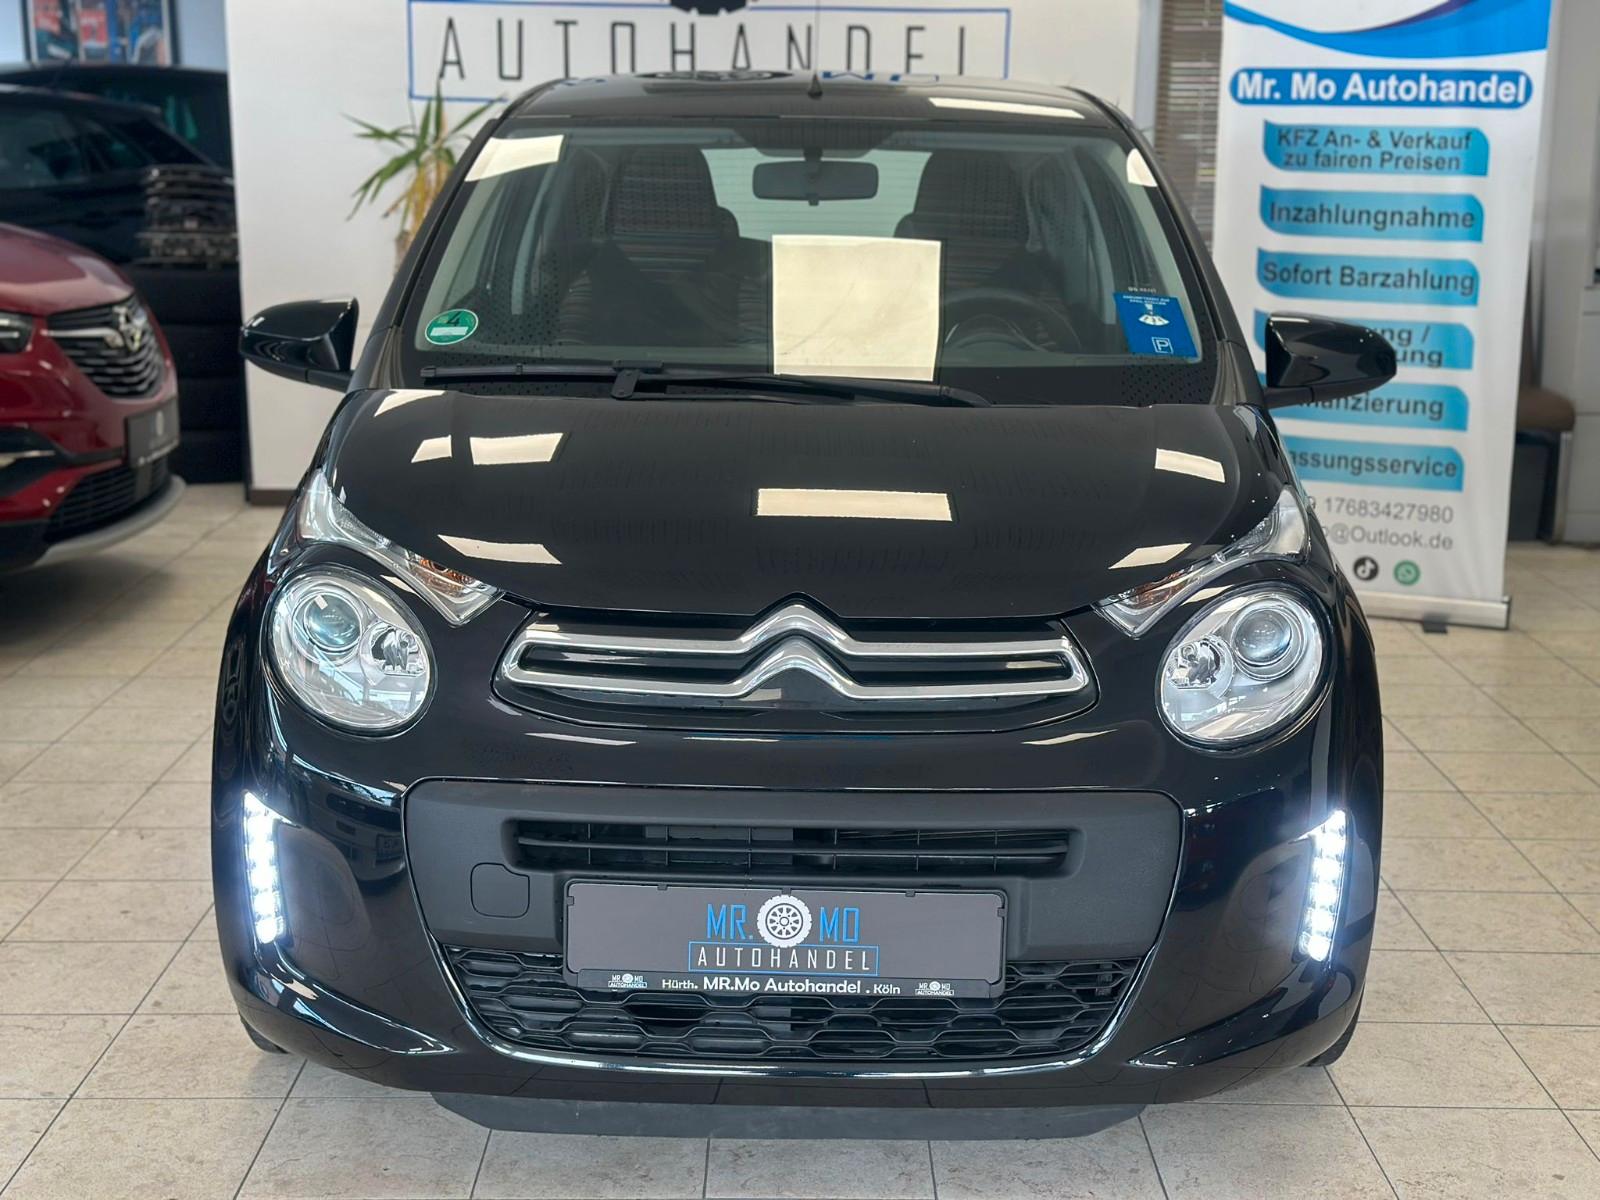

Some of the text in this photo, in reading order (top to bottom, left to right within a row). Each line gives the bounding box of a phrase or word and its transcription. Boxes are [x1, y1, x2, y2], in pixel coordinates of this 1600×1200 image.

[1236, 72, 1527, 103] Mr. Mo Autohandel
[1277, 128, 1473, 150] KFZ An- & Verkauf
[1284, 149, 1460, 170] zu fairen Preisen
[1270, 202, 1475, 231] Inzahlungnahme
[1264, 262, 1475, 297] Sofort Barzahlung
[447, 311, 463, 327] 4
[1325, 497, 1454, 524] 17683427980
[707, 903, 860, 943] MR. MO
[697, 946, 871, 971] AUTOHANDEL
[662, 979, 699, 990] Hürth.
[704, 976, 760, 991] MR.Mo
[764, 977, 861, 994] Autohandel
[873, 983, 901, 995] Köln
